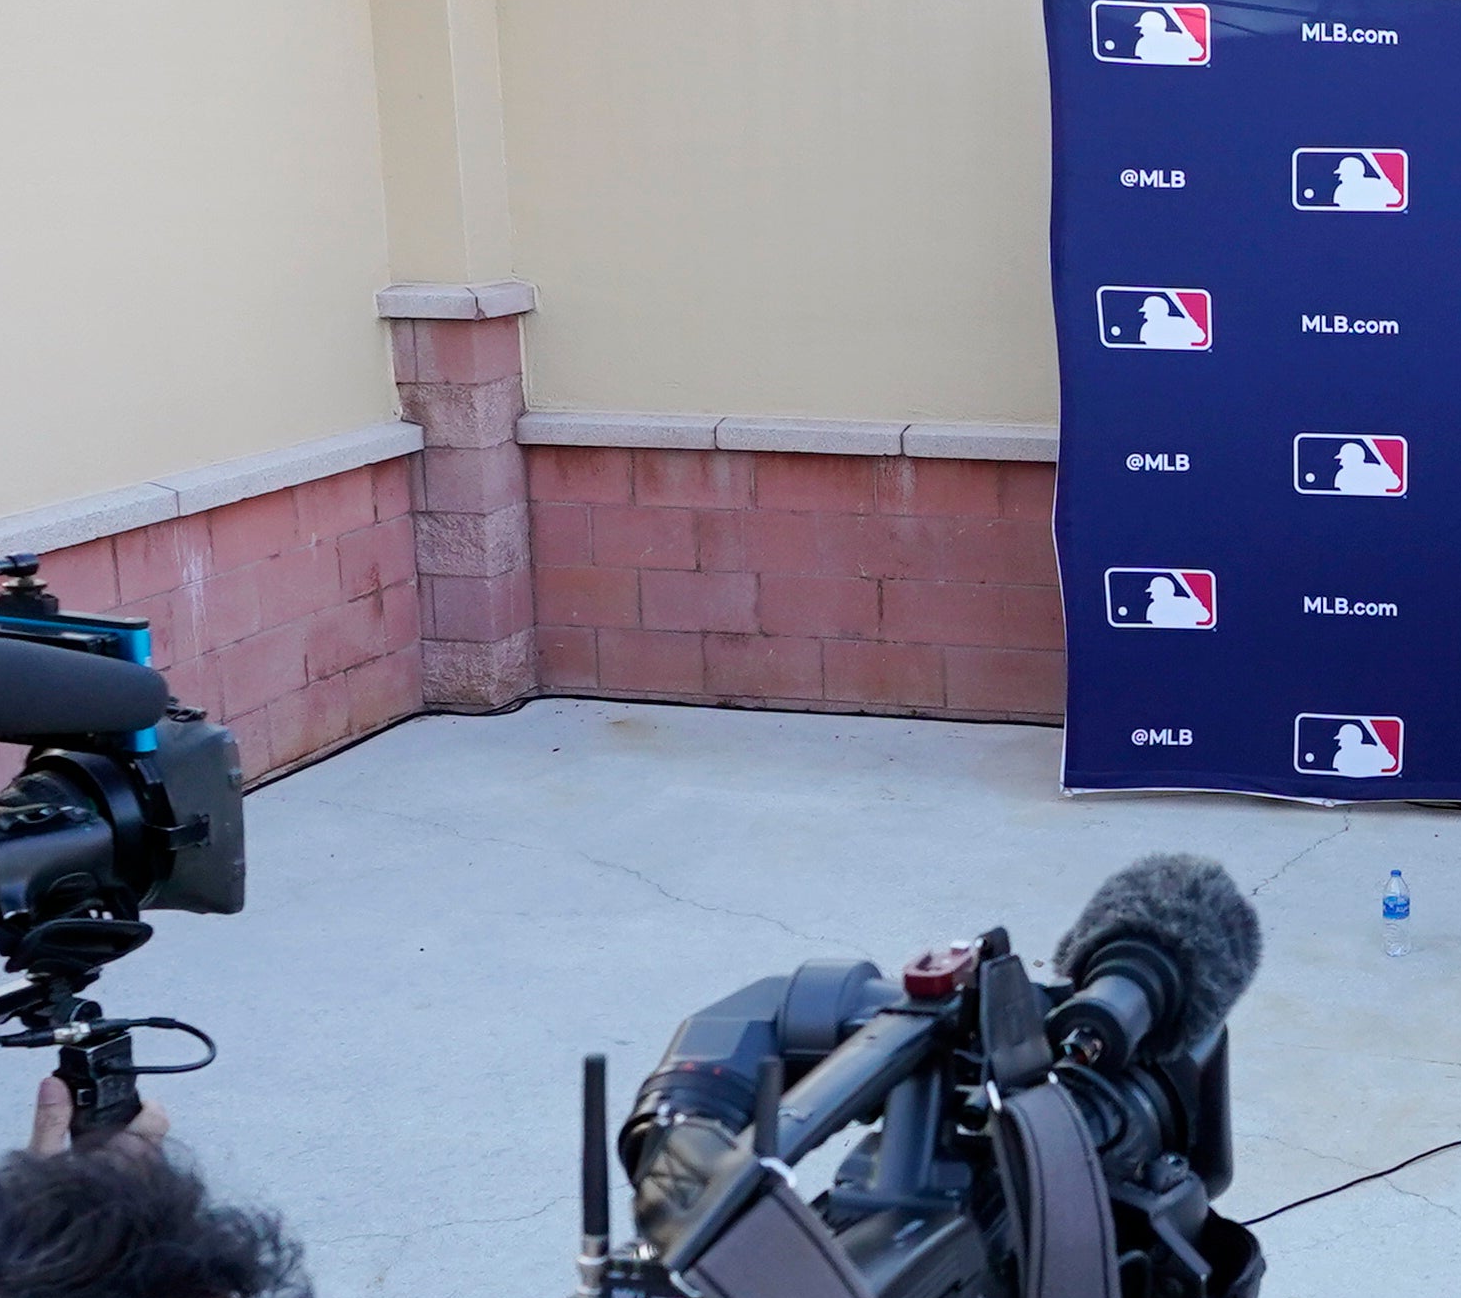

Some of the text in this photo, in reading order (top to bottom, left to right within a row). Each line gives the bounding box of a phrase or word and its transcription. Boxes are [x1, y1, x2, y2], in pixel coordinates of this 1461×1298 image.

[1302, 22, 1398, 45] MLB.com
[1120, 169, 1186, 189] @MLB
[1302, 314, 1399, 334] MLB.com
[1126, 453, 1190, 472] @MLB
[1303, 595, 1398, 617] MLB.com
[1131, 728, 1193, 746] @MLB
